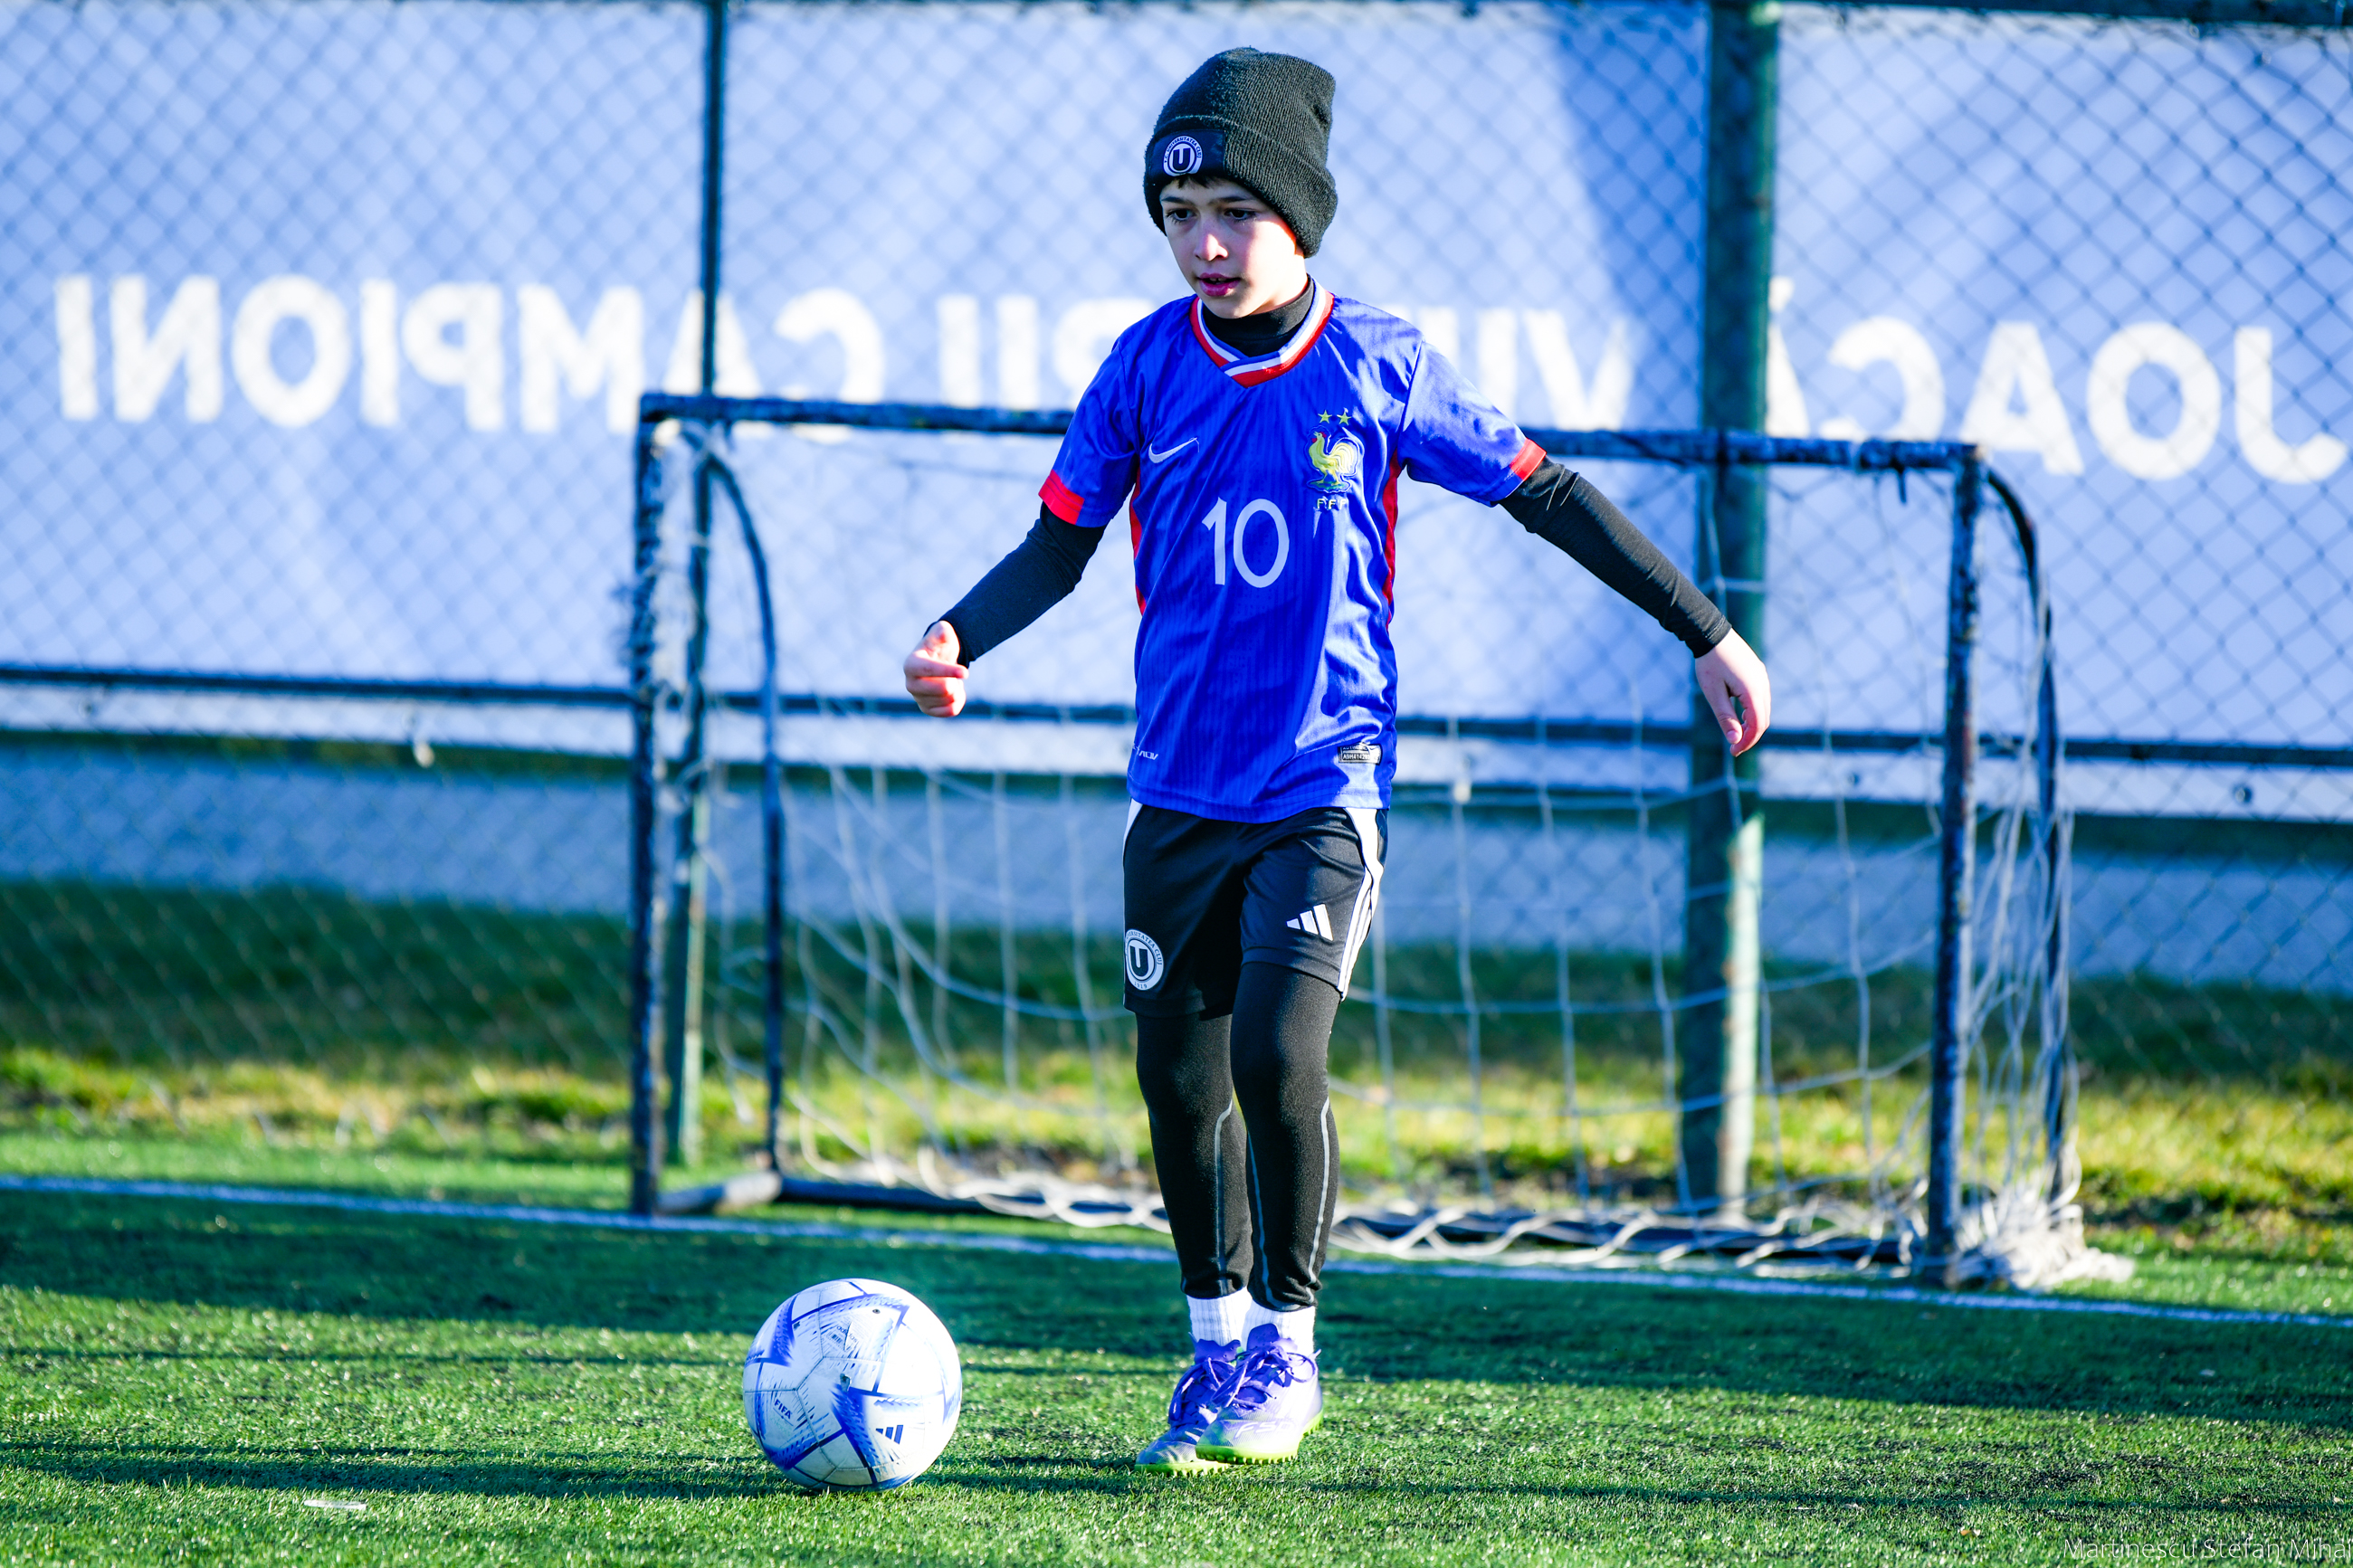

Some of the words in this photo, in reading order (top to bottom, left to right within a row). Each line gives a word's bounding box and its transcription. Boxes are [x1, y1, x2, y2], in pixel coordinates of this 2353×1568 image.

[1173, 147, 1191, 171] U
[1202, 497, 1290, 588] 10
[1129, 946, 1148, 977] U
[1154, 948, 1163, 965] CLUJ
[1134, 981, 1148, 989] 1919
[774, 1399, 793, 1420] FIFA
